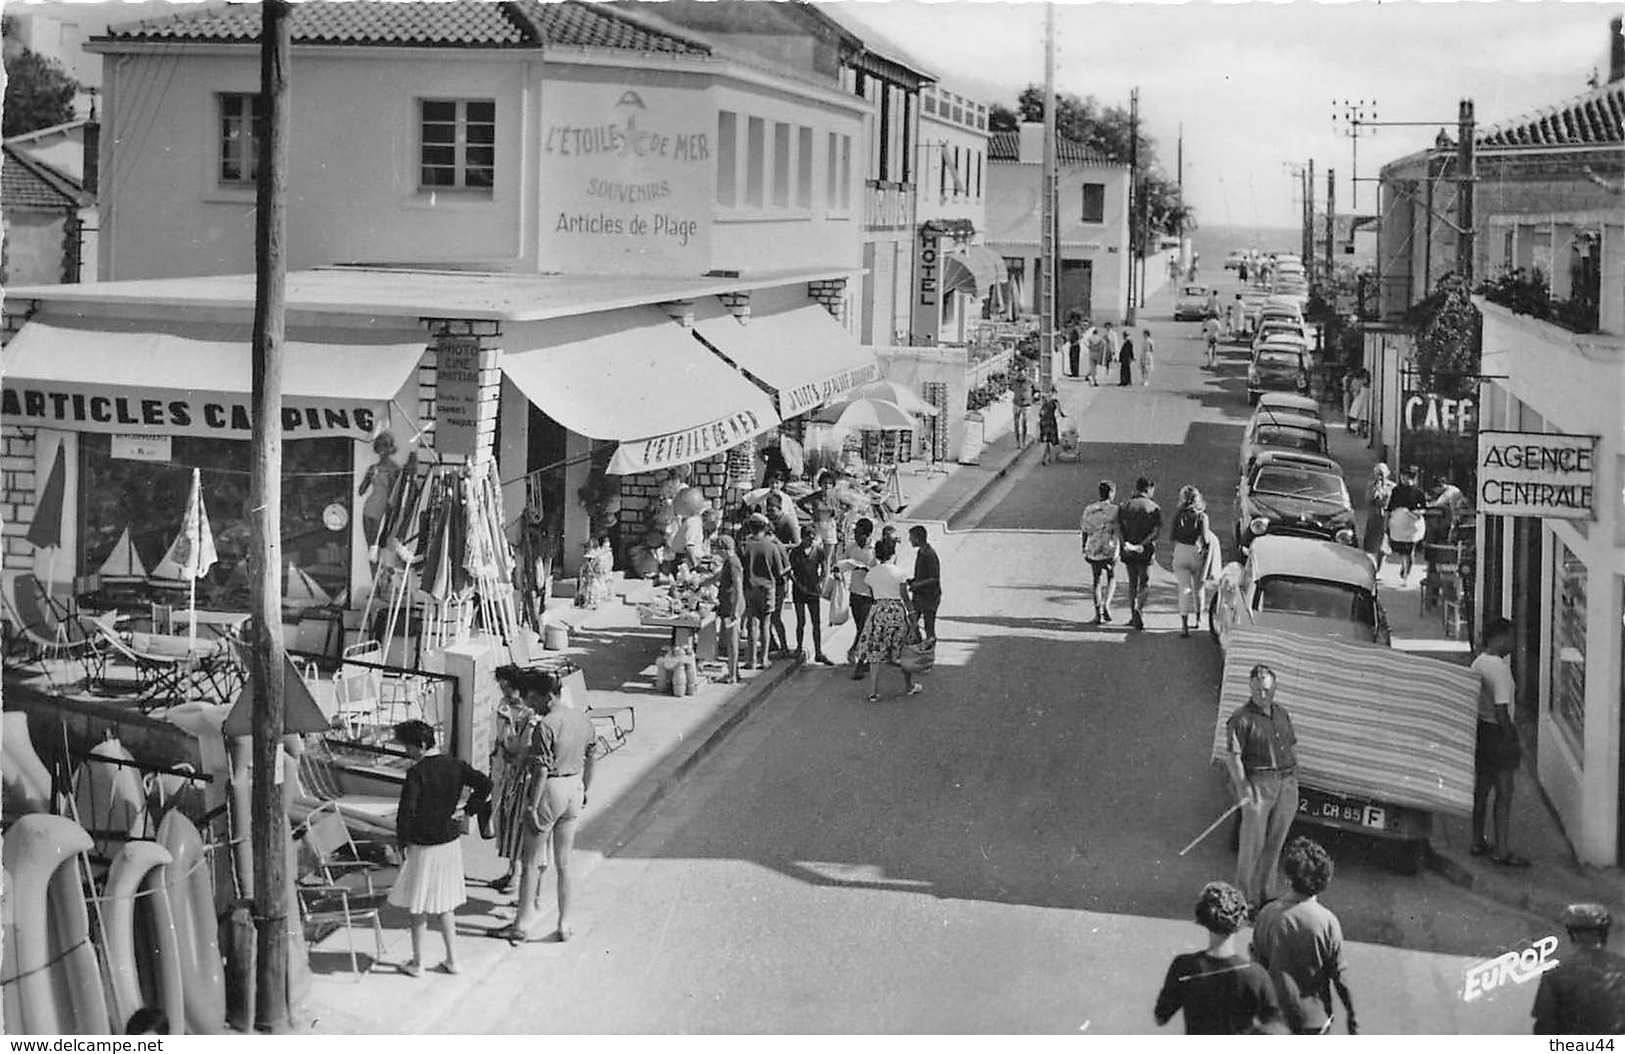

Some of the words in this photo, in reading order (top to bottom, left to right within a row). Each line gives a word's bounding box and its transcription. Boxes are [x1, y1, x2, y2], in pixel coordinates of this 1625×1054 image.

[650, 133, 670, 156] DE
[673, 132, 710, 161] MER
[587, 177, 671, 203] SOUVENIRS
[556, 211, 623, 235] Articles
[630, 213, 647, 236] de
[654, 213, 698, 247] Plage
[921, 235, 937, 306] HOTEL
[2, 388, 192, 427] ARTICLES
[204, 403, 374, 432] CAPING
[1484, 445, 1593, 472] AGENCE
[1482, 479, 1594, 509] CENTRALE
[1368, 808, 1381, 825] F
